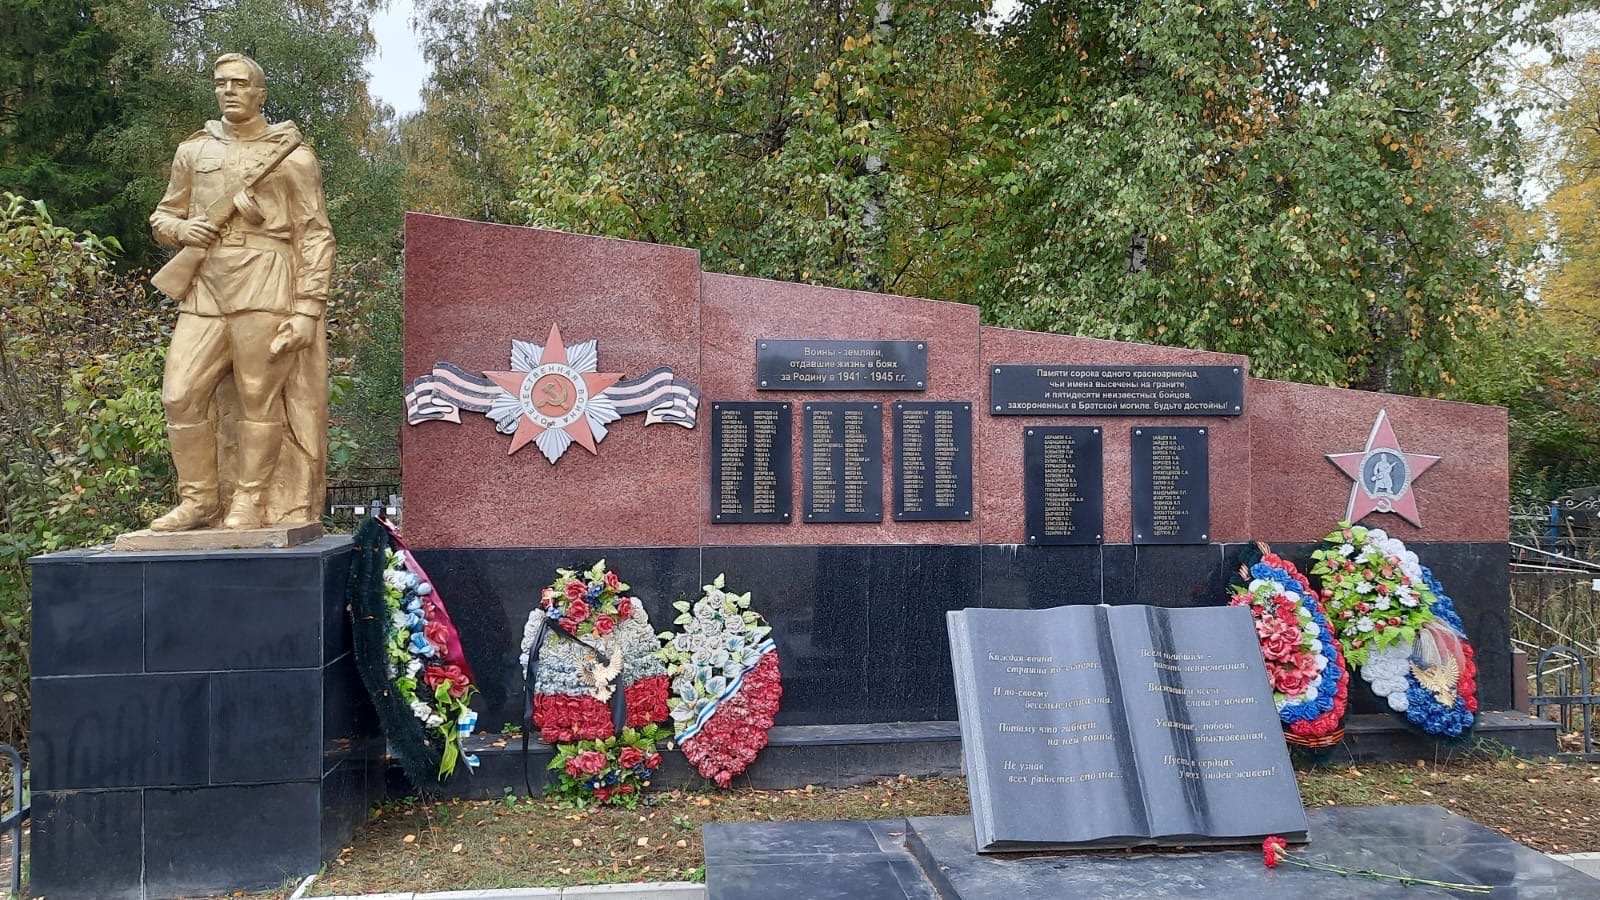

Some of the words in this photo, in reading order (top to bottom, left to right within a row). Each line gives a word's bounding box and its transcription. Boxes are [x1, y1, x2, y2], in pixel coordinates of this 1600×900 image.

[804, 347, 836, 357] Воины
[844, 349, 884, 358] земляки,
[790, 361, 835, 369] отдавшие
[837, 360, 866, 368] жизнь
[875, 359, 897, 368] боях
[793, 373, 826, 383] Родину
[838, 372, 860, 382] 1941
[870, 372, 893, 382] 1945
[1037, 369, 1068, 378] Памяти
[1070, 370, 1100, 380] сорока
[1152, 380, 1187, 390] граните,
[1052, 391, 1101, 400] пятидесяти
[1102, 391, 1157, 399] неизвестных
[1158, 390, 1192, 400] бойцов,
[1008, 402, 1069, 411] захороненных
[1079, 401, 1118, 410] Братской
[1154, 401, 1182, 411] будьте
[1184, 401, 1228, 411] достойны!
[1140, 649, 1162, 658] Всем
[1184, 662, 1249, 674] непременная,
[993, 687, 1000, 696] И
[1004, 689, 1049, 698] по-своему
[998, 722, 1036, 734] Потому
[1039, 726, 1058, 734] что
[1061, 721, 1096, 733] гибнут
[1154, 718, 1198, 731] Уважение,
[1202, 722, 1234, 731] любовь
[1003, 760, 1016, 770] Не
[1020, 763, 1044, 772] узнав
[1197, 759, 1235, 768] сердцах
[1236, 767, 1276, 778] живет!
[1008, 775, 1028, 783] всех
